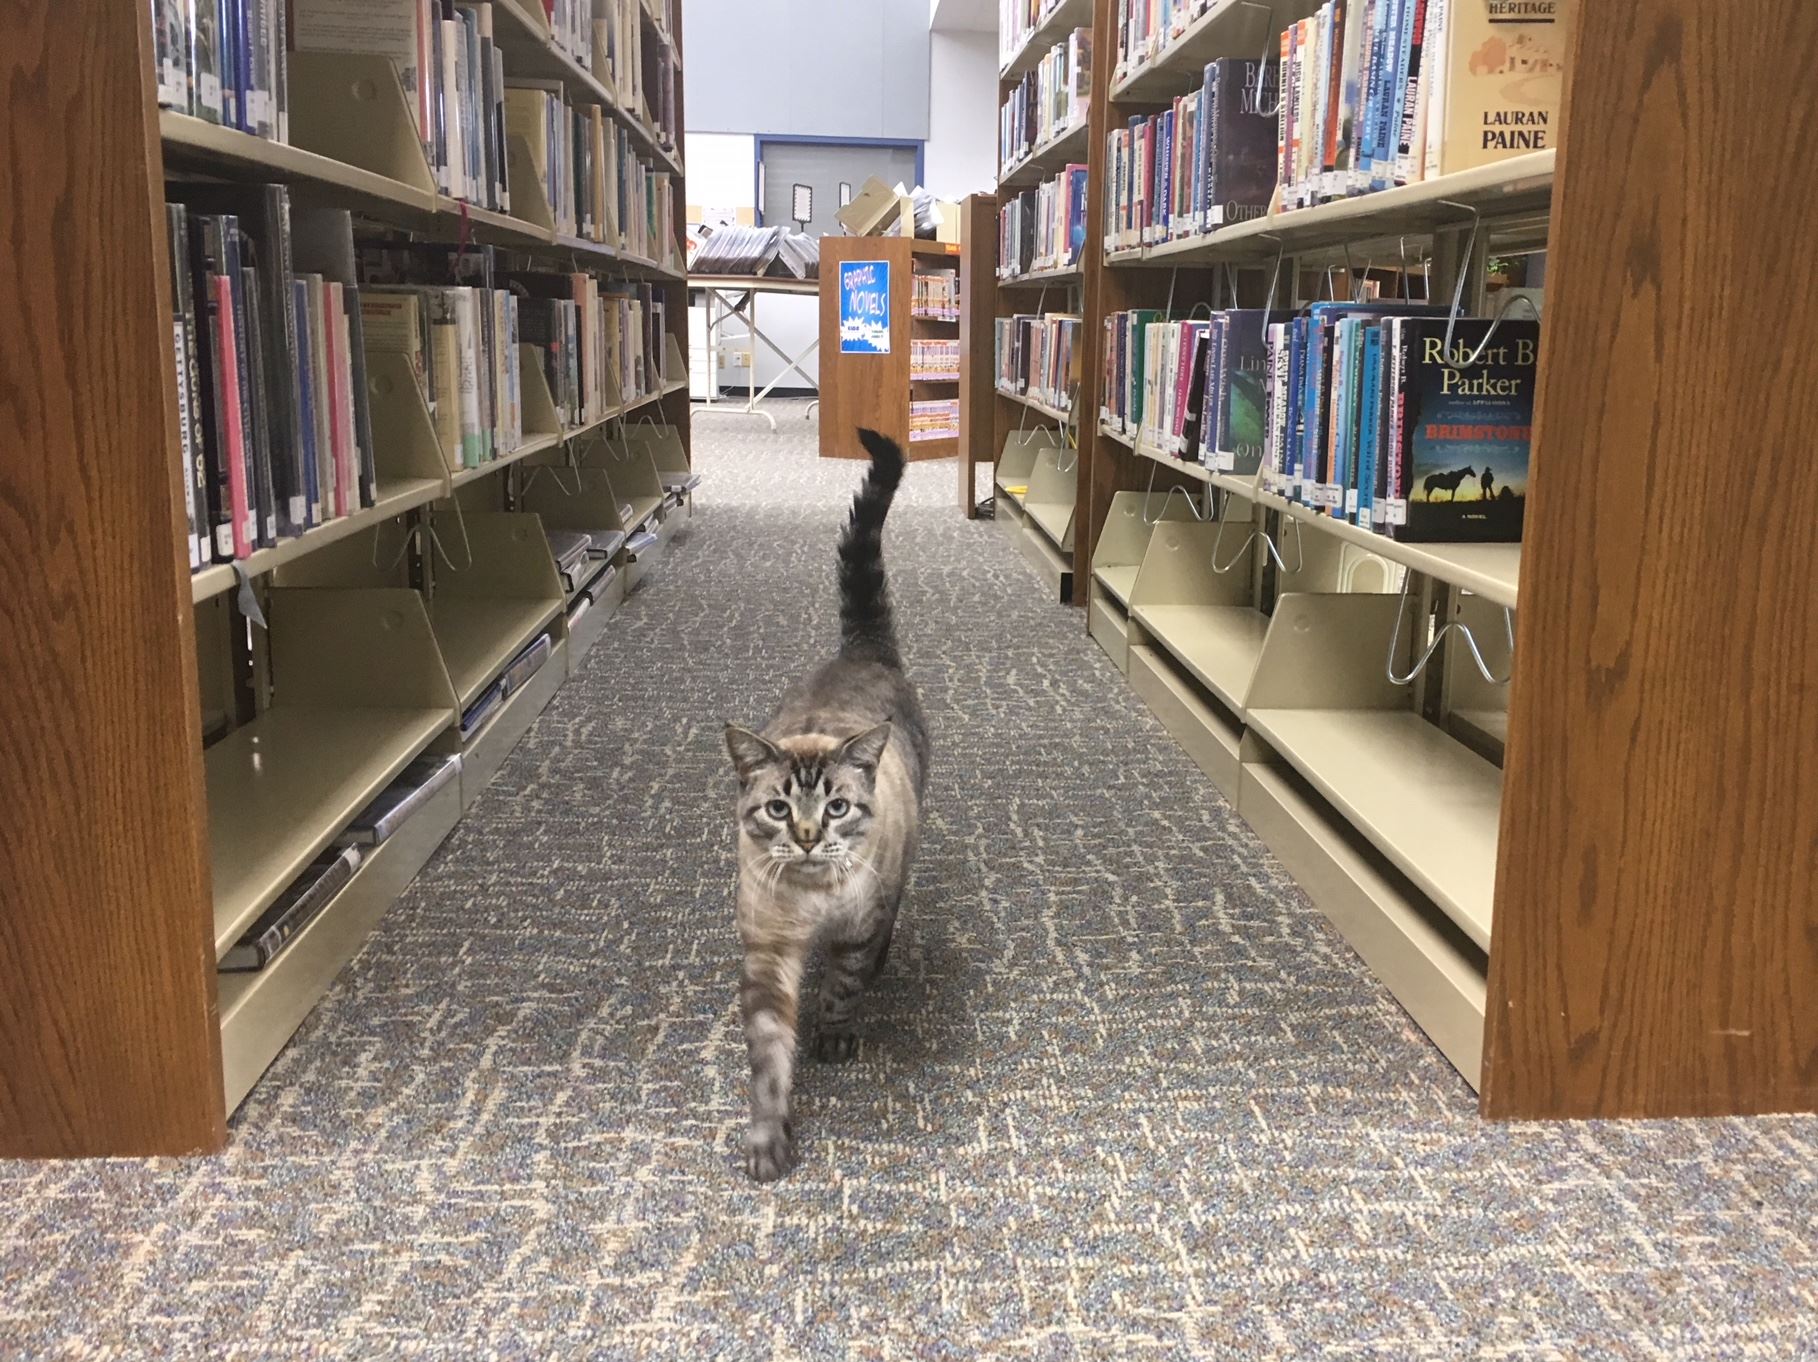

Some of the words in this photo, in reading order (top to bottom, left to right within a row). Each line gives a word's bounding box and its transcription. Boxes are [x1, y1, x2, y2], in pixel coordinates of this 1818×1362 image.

[1488, 2, 1557, 14] HERITAGE
[1386, 31, 1397, 73] MEADOW
[1380, 80, 1392, 118] LAURAN
[1403, 76, 1418, 115] LAURAN
[1399, 117, 1412, 147] PAINE
[1483, 111, 1549, 126] LAURAN
[1376, 121, 1388, 149] PAINE
[1482, 130, 1547, 150] PAINE
[844, 265, 876, 291] GRAPHIC
[849, 290, 886, 316] NOVELS
[1266, 340, 1275, 380] PAINE
[1401, 344, 1409, 374] Robert
[1422, 337, 1508, 366] Robert
[174, 333, 189, 455] GETTYSBURG
[1440, 368, 1522, 396] Parker
[1394, 391, 1405, 499] BRIMSTON
